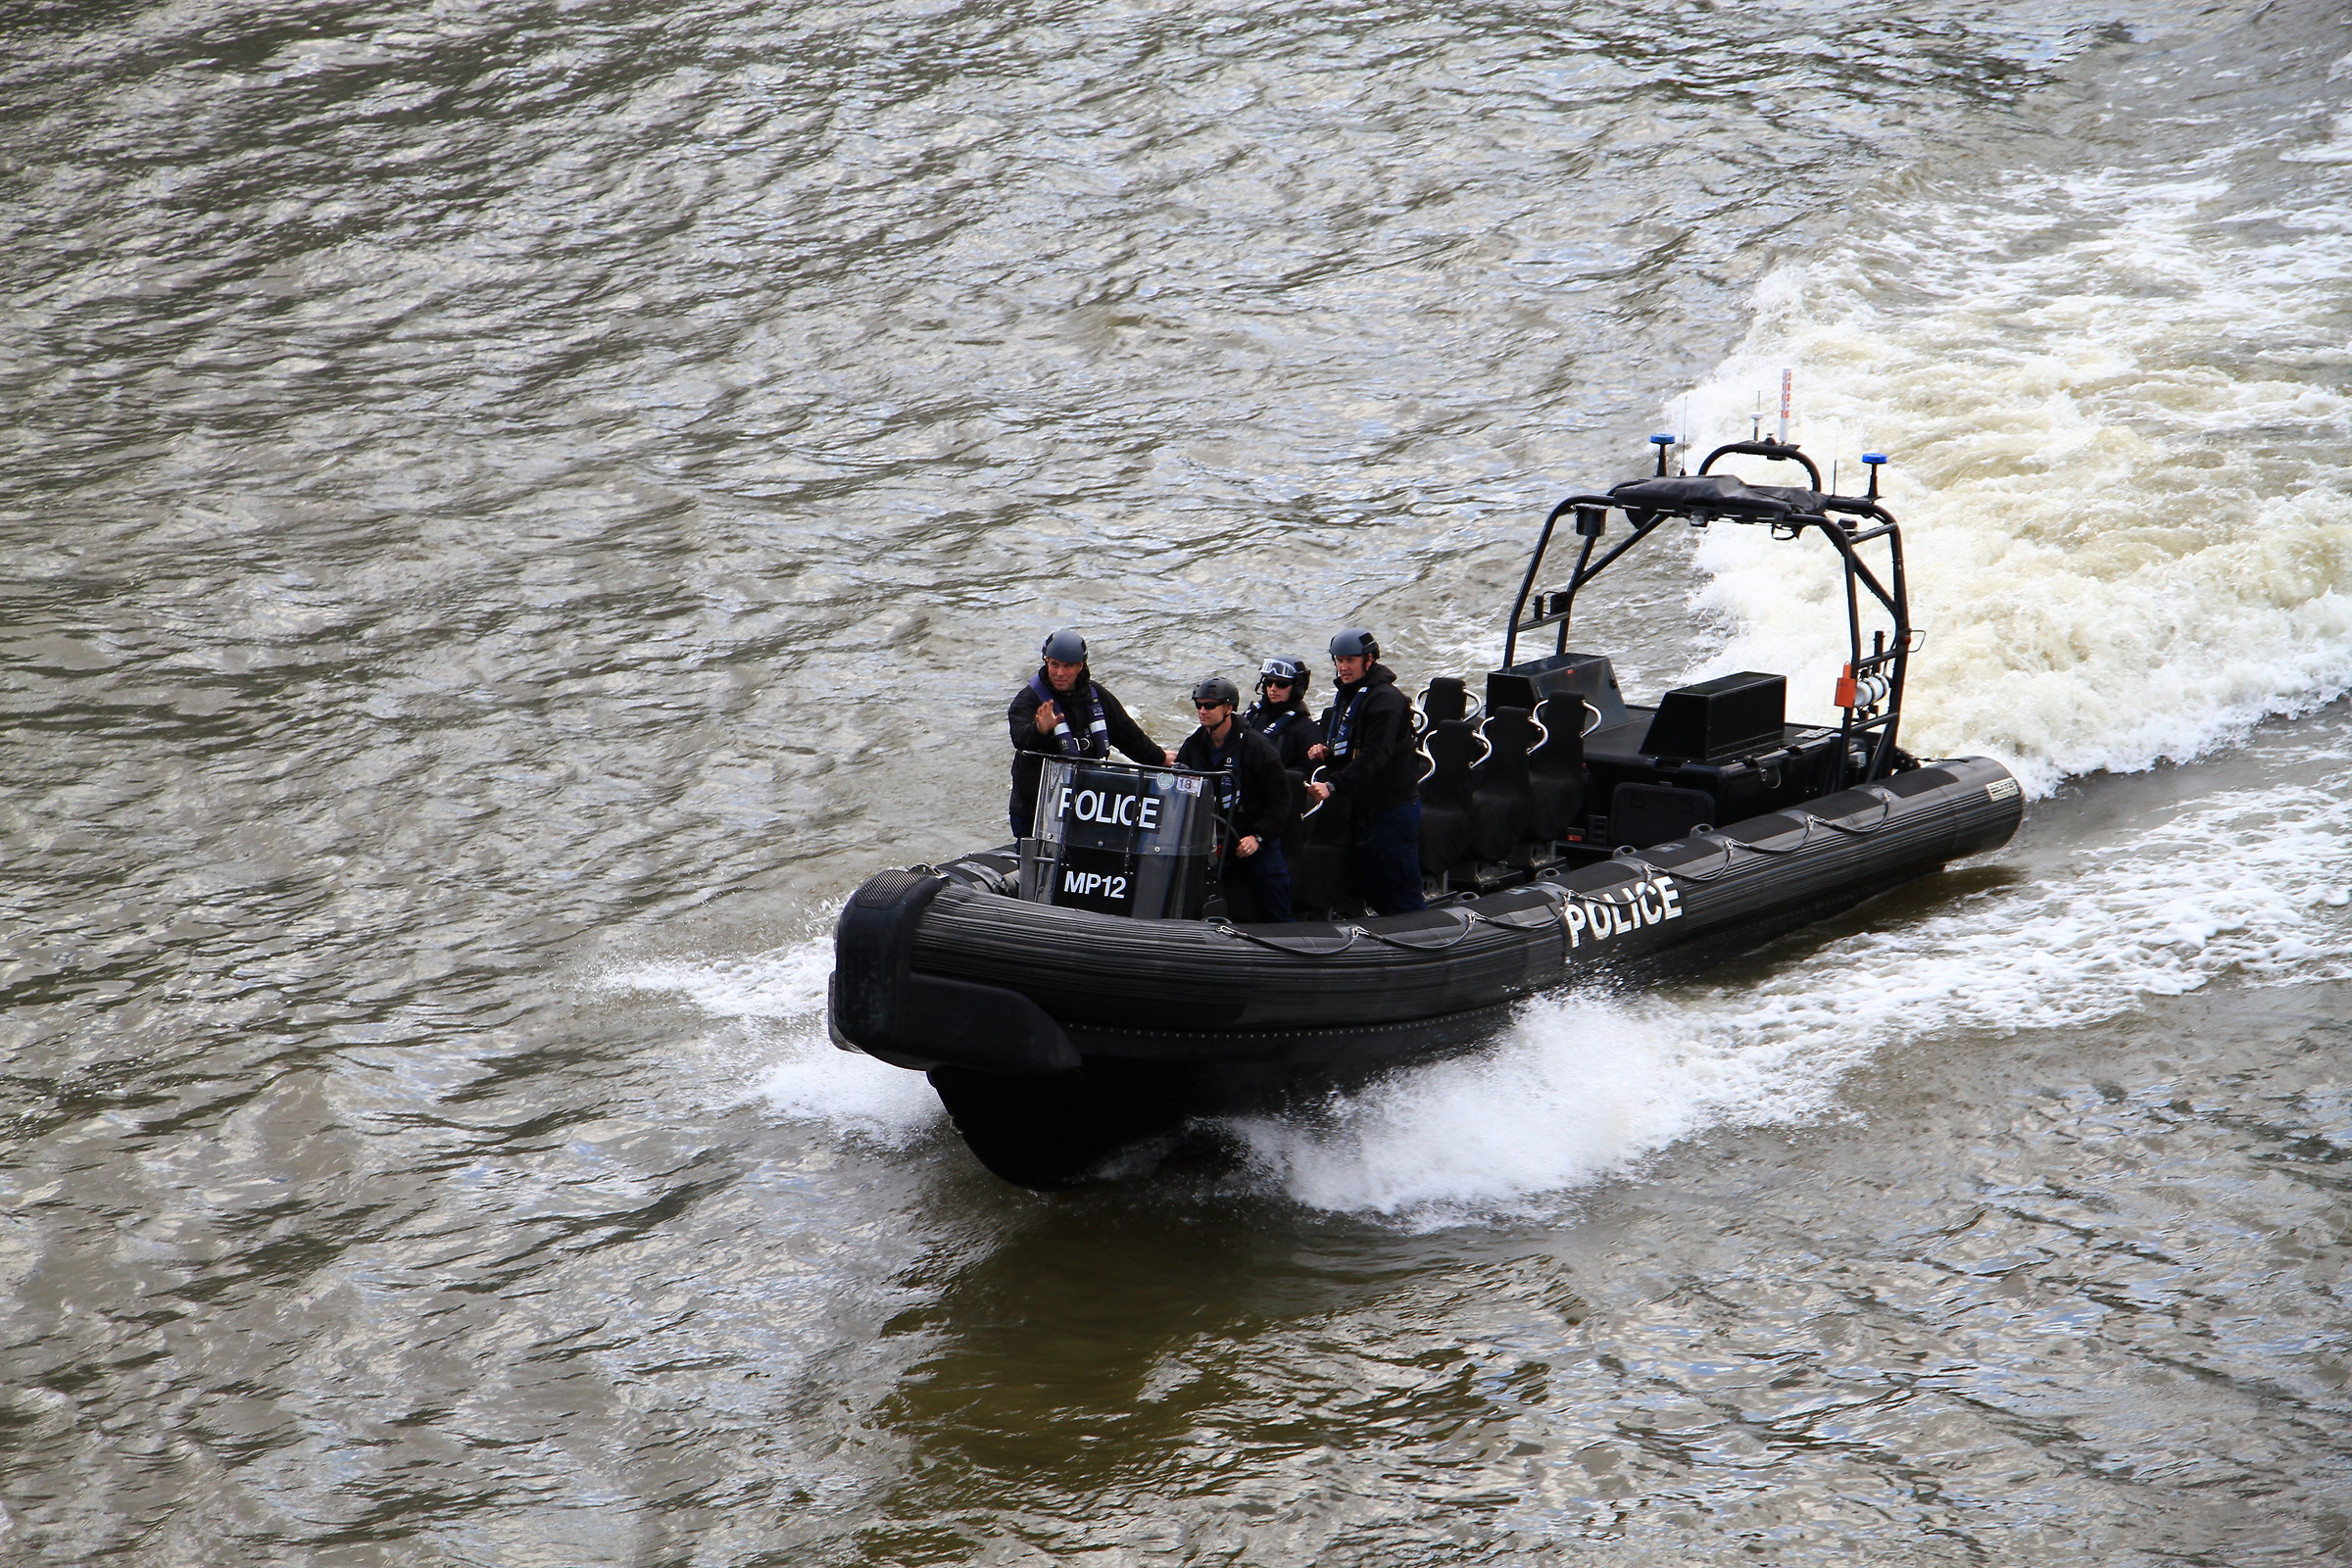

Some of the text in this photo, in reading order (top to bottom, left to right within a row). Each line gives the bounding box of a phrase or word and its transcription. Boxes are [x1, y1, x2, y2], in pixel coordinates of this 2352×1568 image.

[1057, 787, 1161, 830] POLICE
[1063, 870, 1127, 899] MP12
[1559, 875, 1683, 949] POLICE
